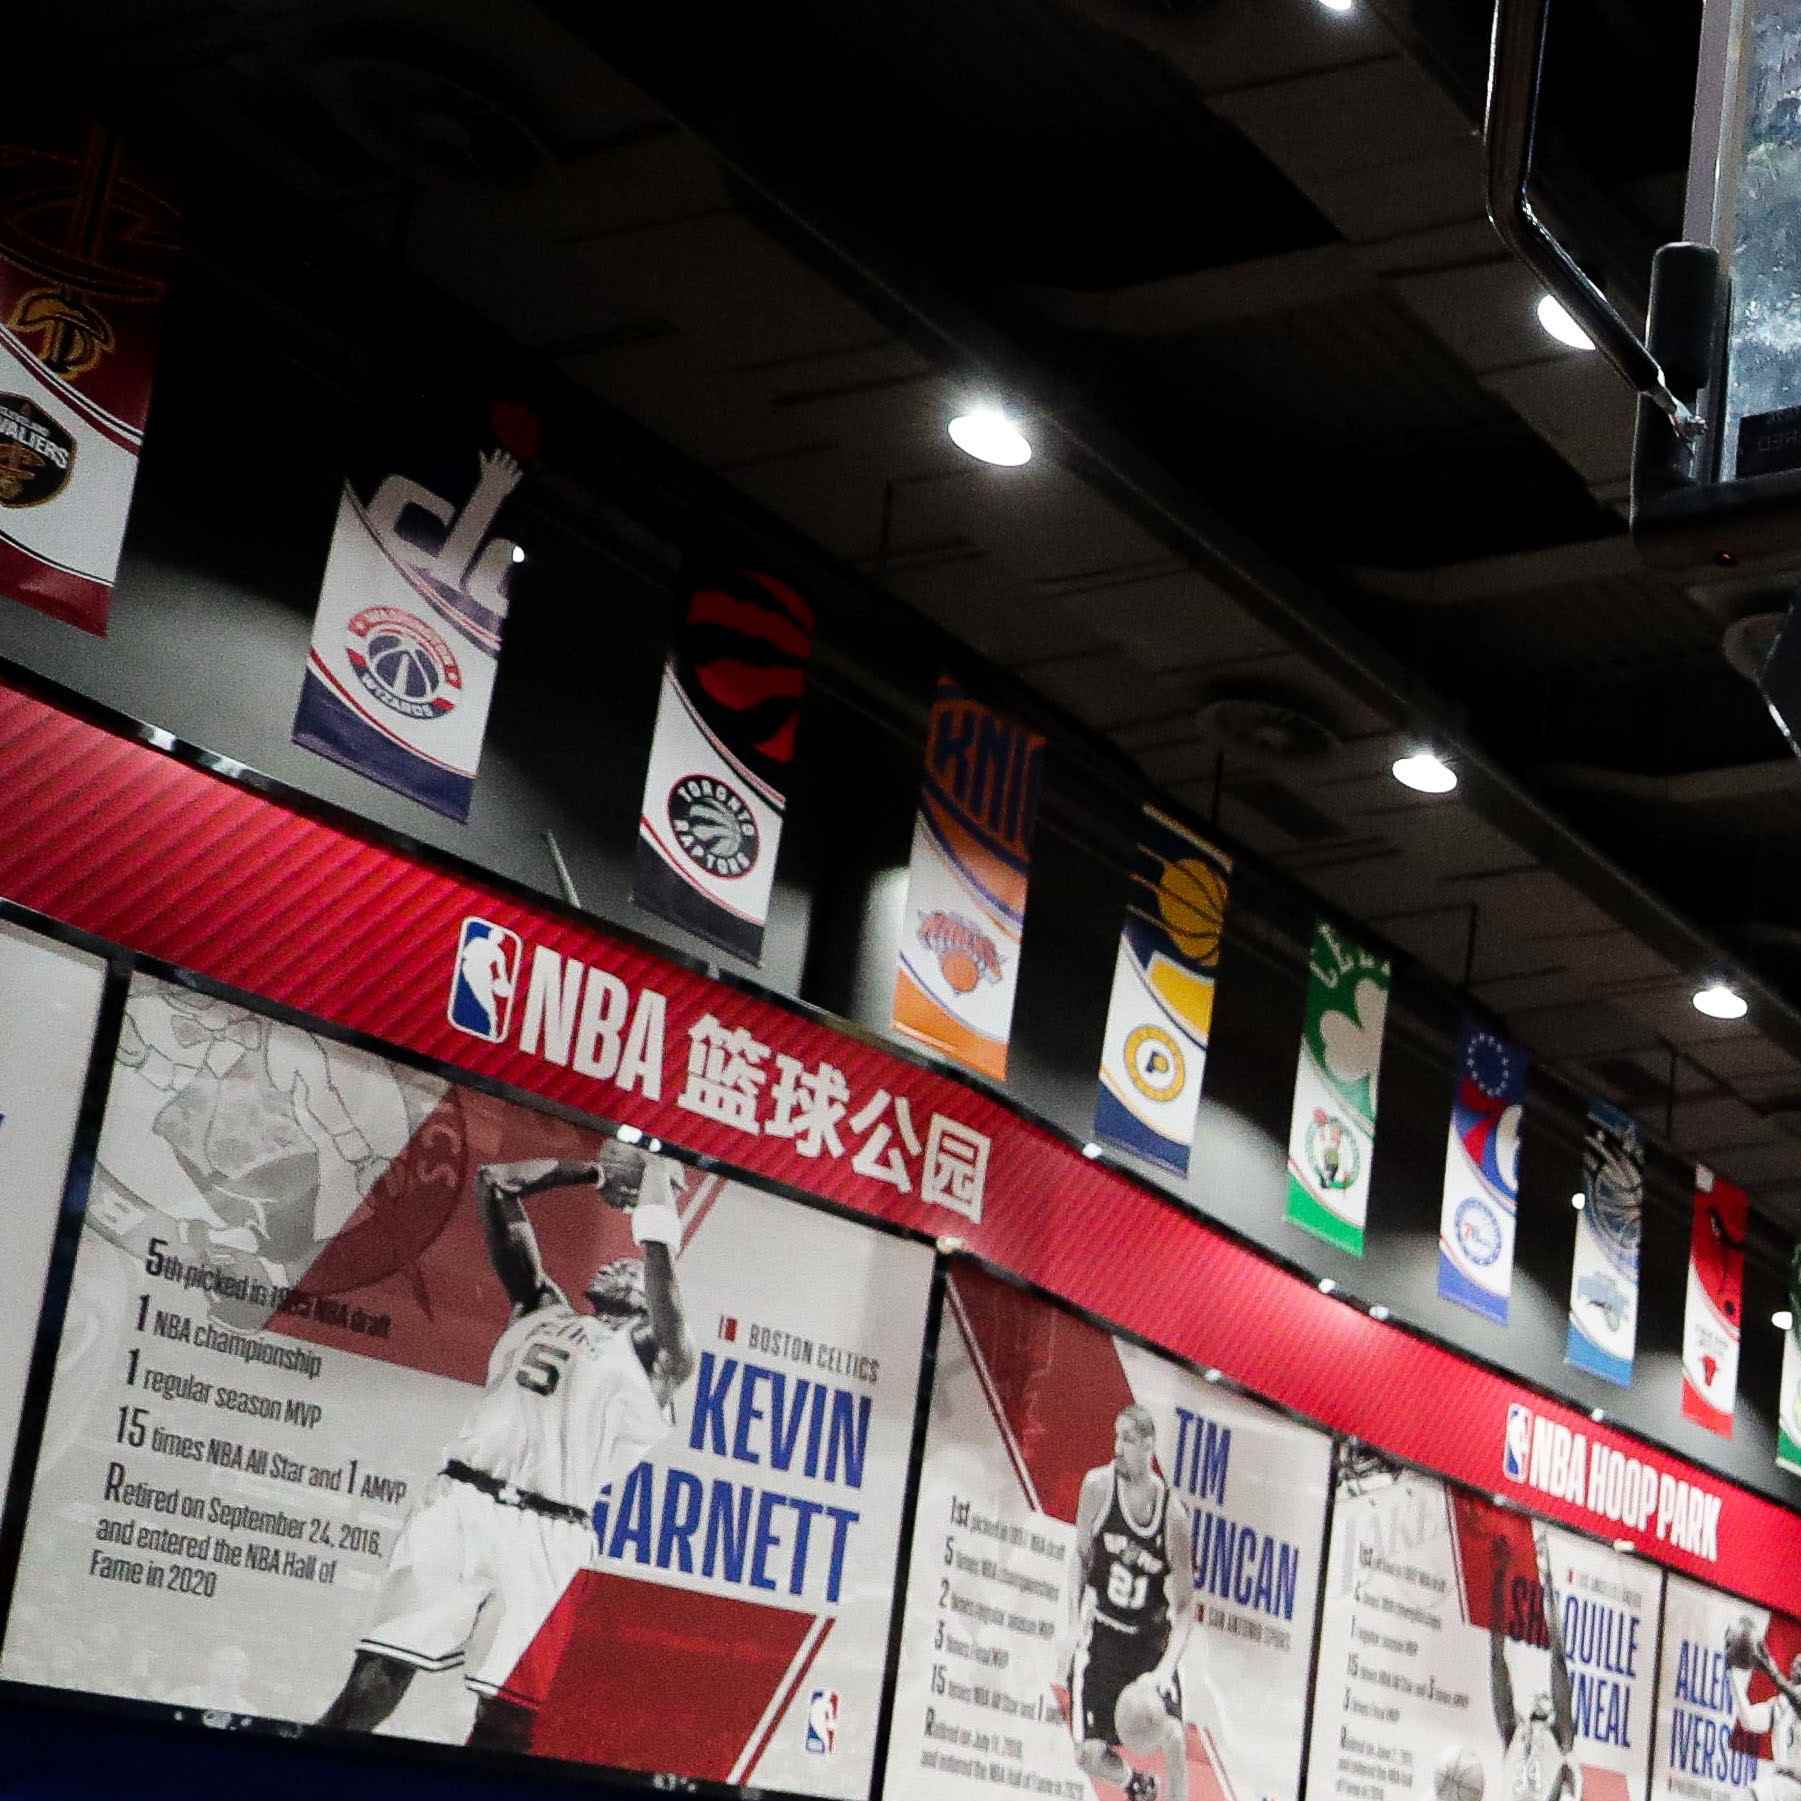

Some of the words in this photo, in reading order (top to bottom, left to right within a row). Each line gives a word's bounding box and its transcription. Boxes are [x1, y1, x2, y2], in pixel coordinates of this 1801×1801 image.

[678, 780, 755, 836] TORONTO
[673, 820, 750, 875] RAPTORS
[519, 943, 666, 1102] NBA
[676, 1015, 993, 1225] 篮球公园
[146, 1238, 182, 1283] 5th
[185, 1262, 249, 1301] picked
[136, 1295, 151, 1333] 1
[153, 1310, 191, 1345] NBA
[194, 1322, 323, 1380] championship
[515, 1342, 570, 1397] 5
[748, 1323, 813, 1364] BOSTON
[816, 1341, 879, 1385] CELTICS
[126, 1348, 140, 1386] 1
[143, 1366, 211, 1401] regular
[214, 1384, 283, 1421] season
[284, 1398, 322, 1430] MVP
[690, 1351, 872, 1489] KEVIN
[117, 1406, 150, 1448] 15
[152, 1427, 205, 1463] times
[207, 1438, 242, 1470] NBA
[245, 1445, 267, 1476] All
[270, 1454, 306, 1484] Star
[308, 1464, 342, 1494] and
[345, 1460, 358, 1494] 1
[1173, 1406, 1232, 1505] TIM
[104, 1462, 178, 1514] Retired
[181, 1492, 205, 1516] on
[207, 1497, 307, 1542] September
[1528, 1416, 1587, 1510] NBA
[1588, 1443, 1657, 1536] HOOP
[1657, 1477, 1722, 1562] PARK
[89, 1549, 142, 1586] Fame
[145, 1561, 164, 1587] in
[166, 1564, 217, 1598] 2020
[96, 1517, 134, 1545] and
[137, 1527, 211, 1561] entered
[213, 1538, 243, 1568] the
[245, 1545, 281, 1575] NBA
[283, 1554, 317, 1581] Hall
[318, 1559, 338, 1585] of
[944, 1536, 955, 1567] 5
[1192, 1508, 1299, 1621] UNCAN
[938, 1577, 950, 1608] 2
[934, 1620, 945, 1650] 3
[931, 1664, 947, 1694] 15
[1675, 1638, 1733, 1715] ALLEN
[1669, 1707, 1758, 1787] IVERSON
